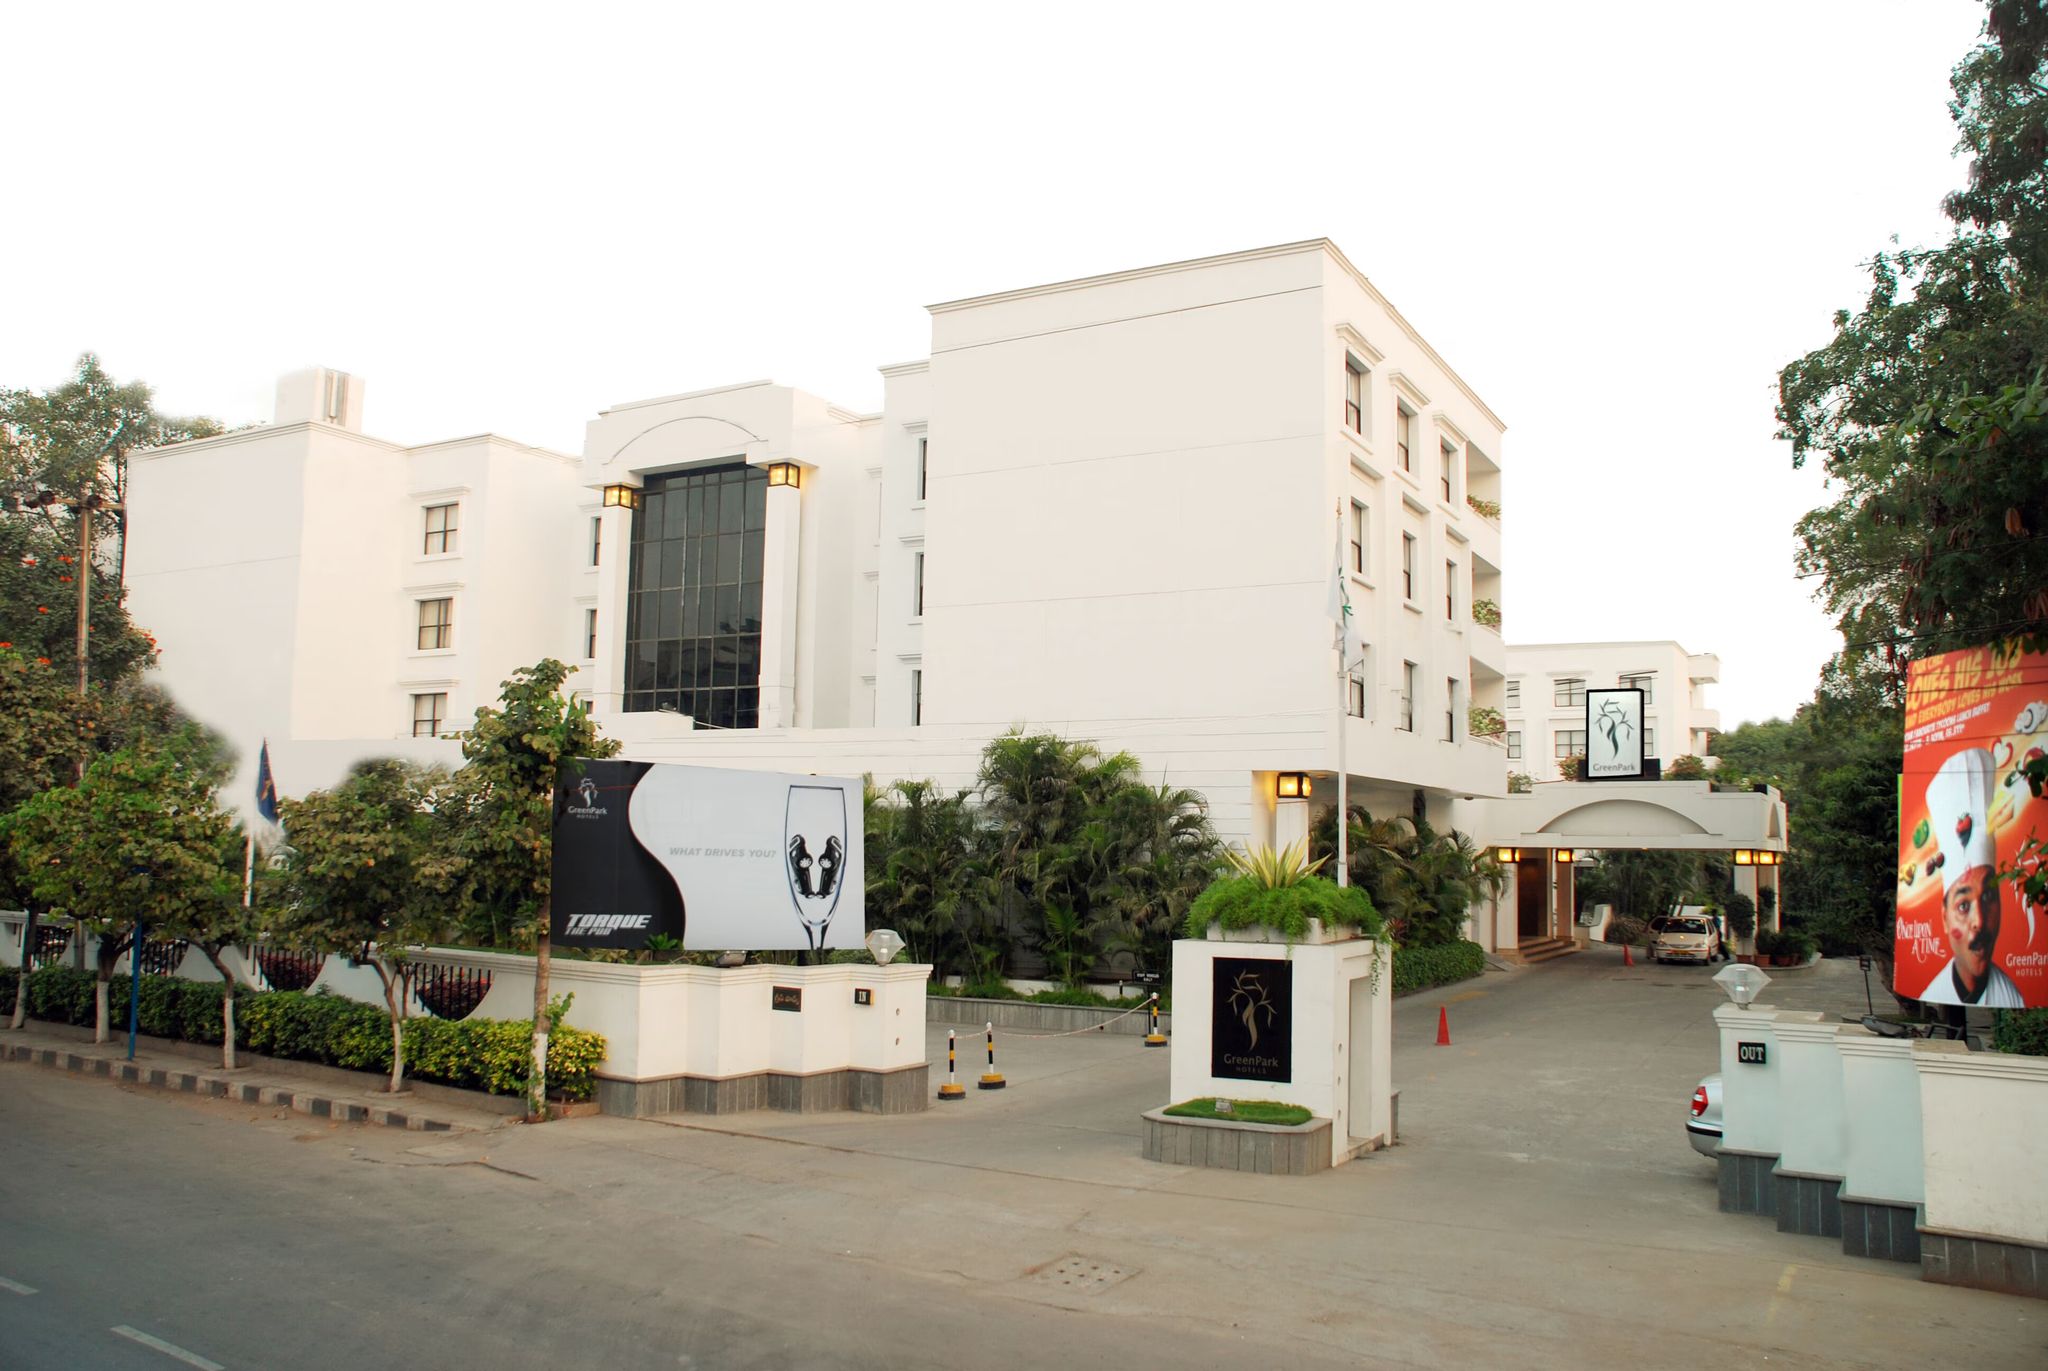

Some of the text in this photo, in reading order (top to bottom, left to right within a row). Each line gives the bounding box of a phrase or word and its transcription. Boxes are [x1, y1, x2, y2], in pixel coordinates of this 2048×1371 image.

[1905, 664, 1951, 711] LOVES
[1954, 650, 1983, 691] HIS
[1593, 763, 1635, 771] GreenPark
[567, 805, 607, 815] GreenPark
[669, 847, 777, 858] WHAT DRIVES YOU?
[567, 913, 653, 930] TORQUE
[2015, 967, 2043, 977] HOTELS
[1740, 1046, 1764, 1060] OUT
[1224, 1053, 1279, 1067] GreenPark
